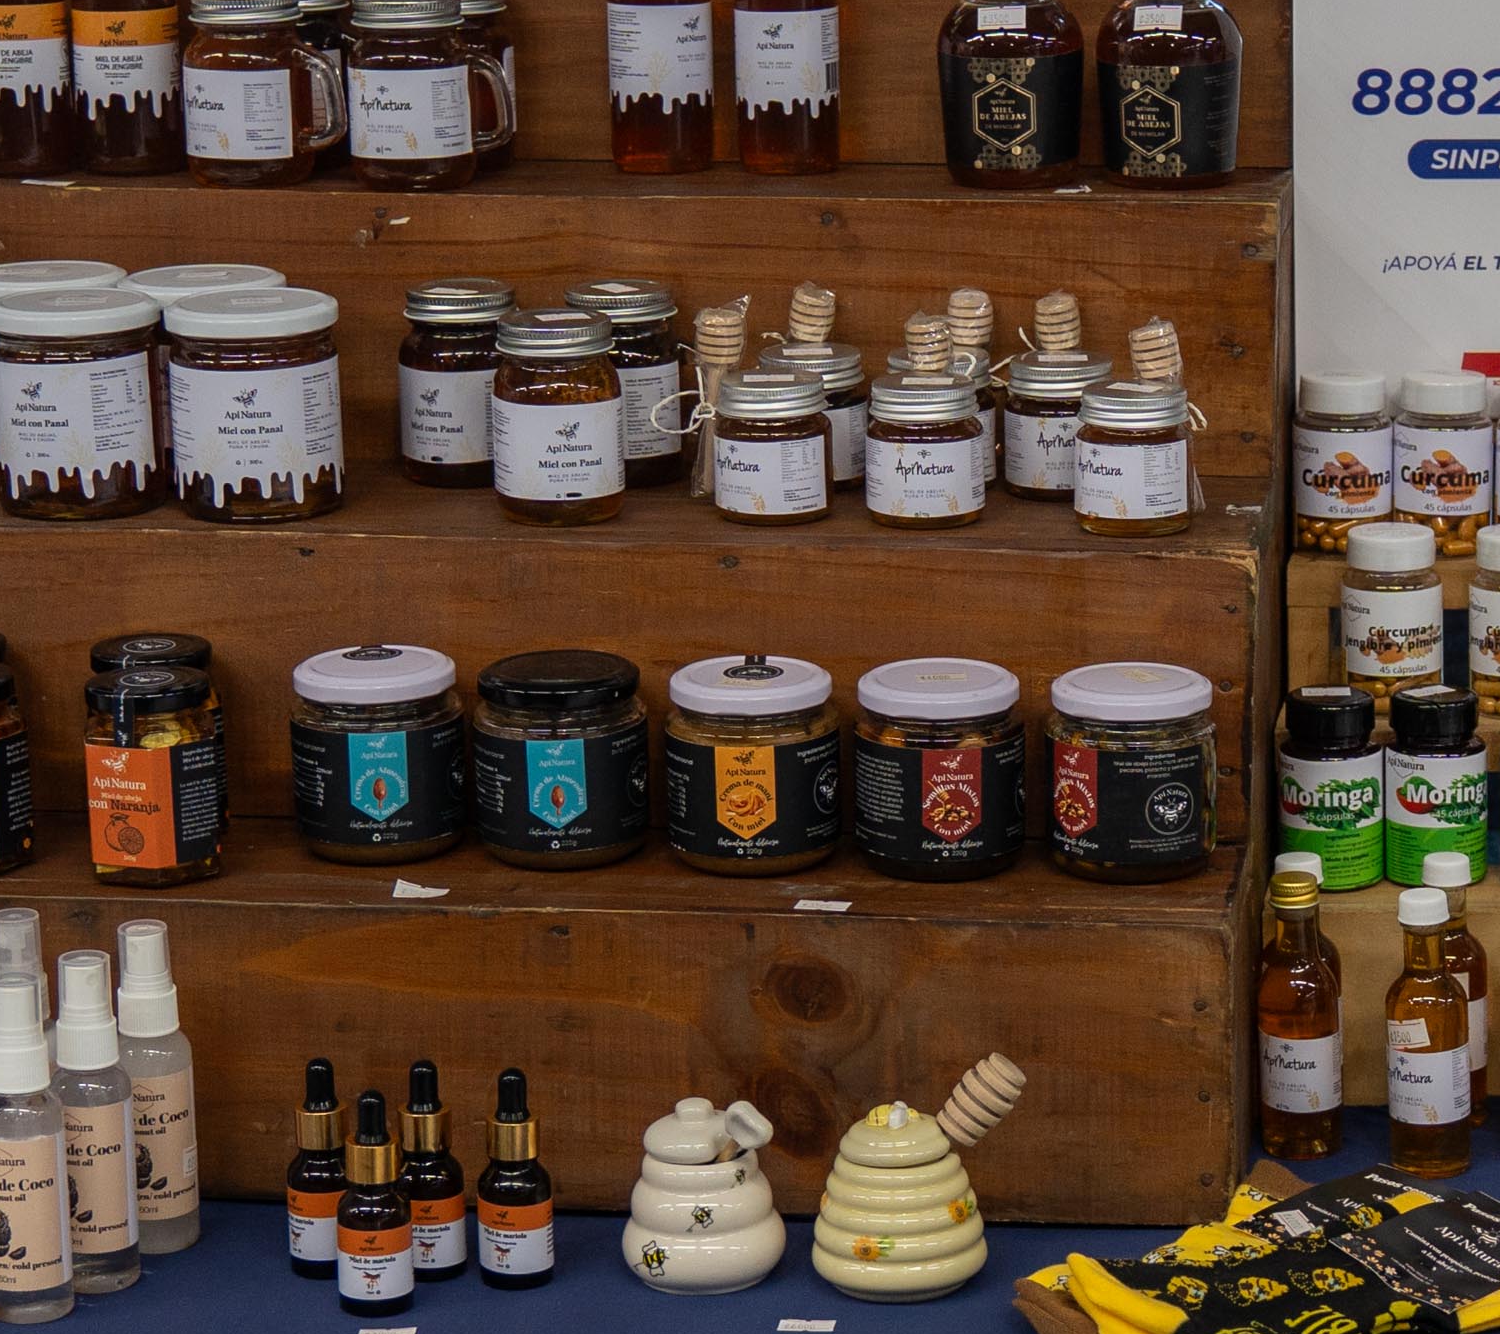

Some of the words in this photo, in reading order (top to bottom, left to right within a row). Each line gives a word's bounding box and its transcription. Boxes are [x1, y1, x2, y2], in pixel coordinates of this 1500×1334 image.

[1383, 253, 1458, 273] ¡APOYÁ
[1463, 255, 1487, 271] EL
[241, 410, 272, 419] Natura
[218, 426, 238, 435] Miel
[240, 427, 256, 435] con
[258, 425, 284, 435] Panal
[1302, 466, 1391, 489] Cúrcuma
[1400, 465, 1490, 487] Cúrcuma
[1328, 505, 1338, 513] 45
[1340, 504, 1376, 515] cápsulas
[1283, 783, 1373, 811] Moringa
[89, 800, 109, 810] con
[110, 800, 161, 816] Naranja
